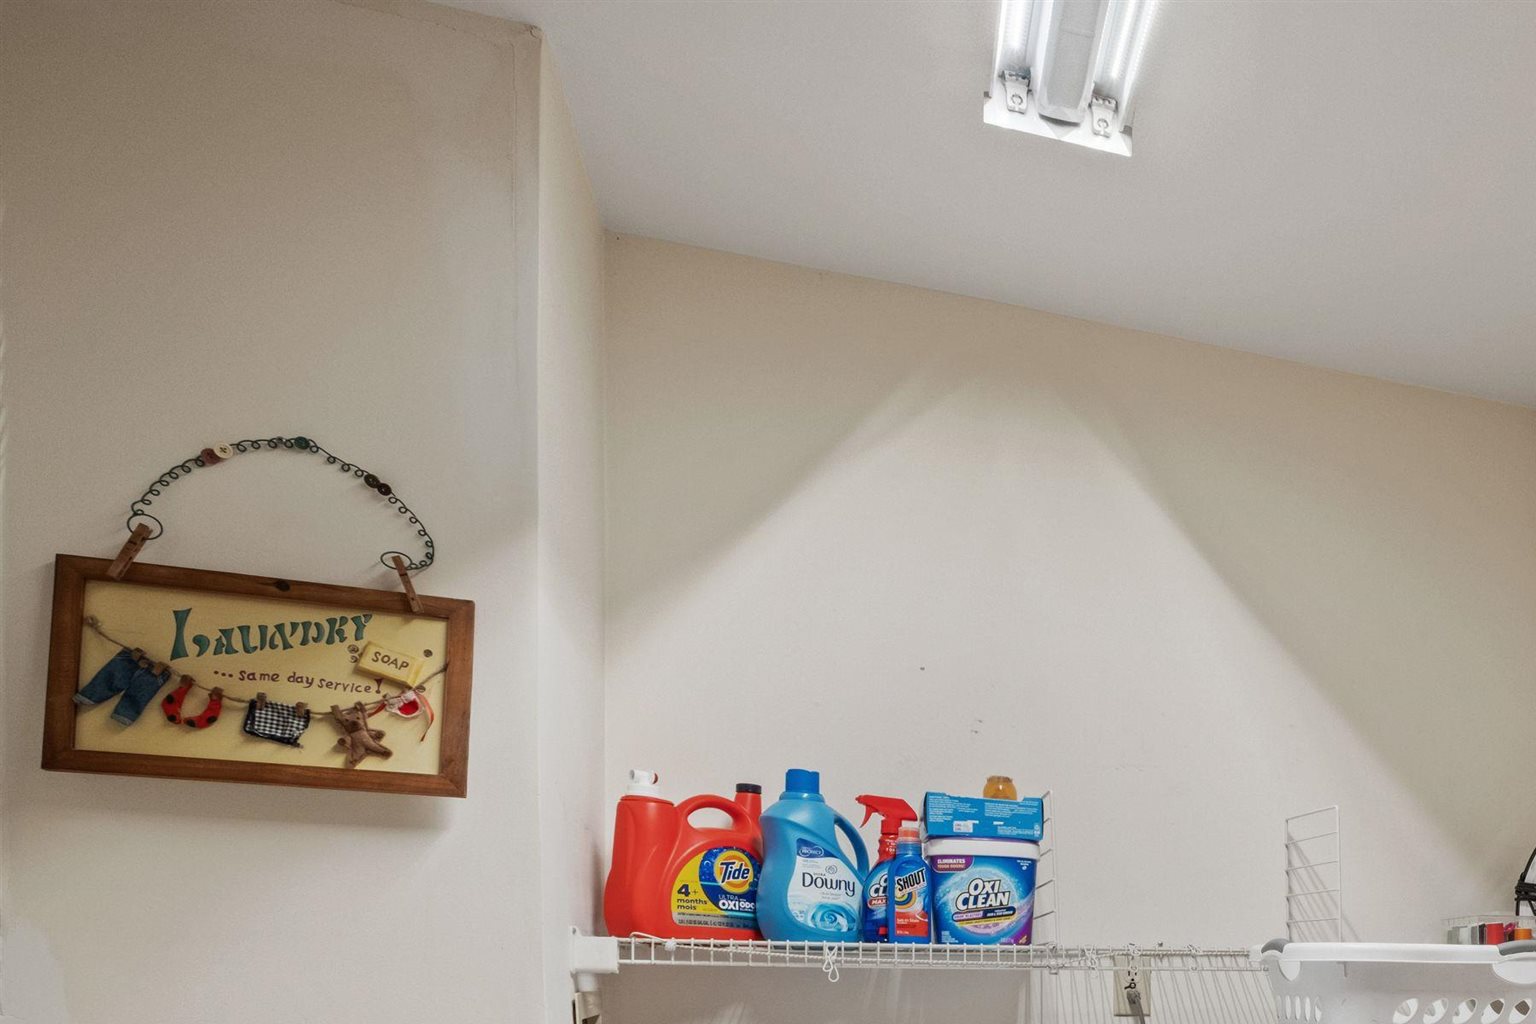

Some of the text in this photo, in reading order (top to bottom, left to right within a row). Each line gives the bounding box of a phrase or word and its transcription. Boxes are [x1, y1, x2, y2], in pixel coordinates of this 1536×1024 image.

[170, 607, 373, 661] LAUNDRY
[371, 651, 410, 671] SOAP
[238, 670, 280, 682] same
[287, 671, 315, 688] day
[719, 861, 750, 884] Tide
[896, 868, 926, 892] SHOUT
[802, 871, 855, 898] Downy
[968, 878, 1001, 896] OXI
[718, 900, 739, 910] OXI
[955, 891, 1011, 911] CLEAN
